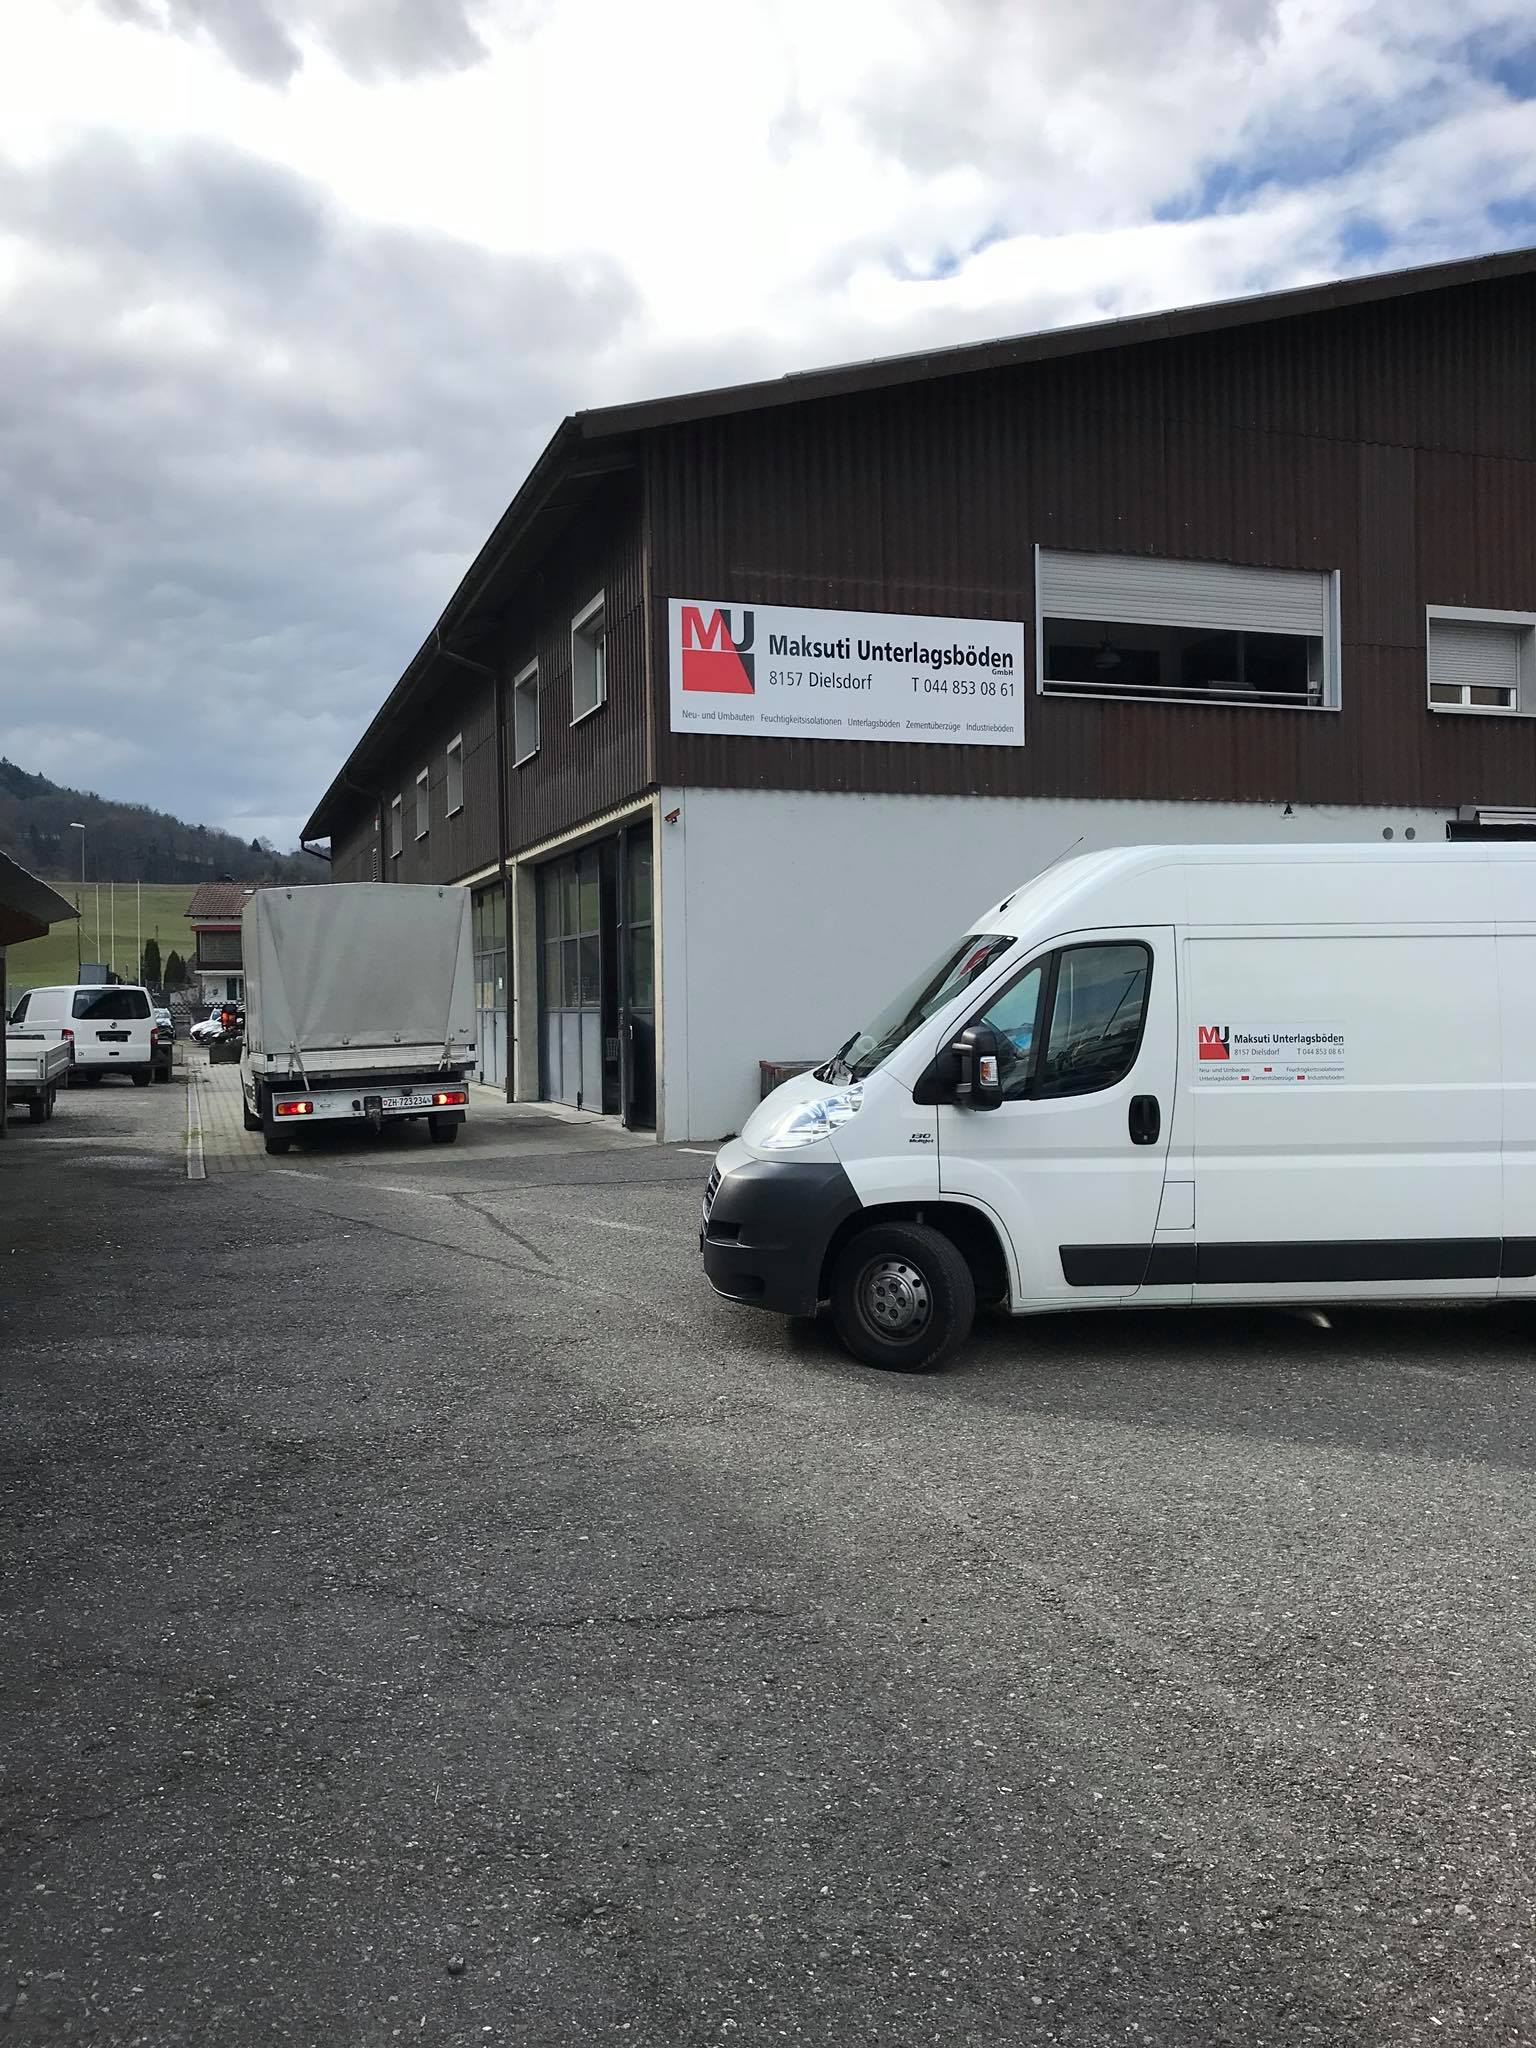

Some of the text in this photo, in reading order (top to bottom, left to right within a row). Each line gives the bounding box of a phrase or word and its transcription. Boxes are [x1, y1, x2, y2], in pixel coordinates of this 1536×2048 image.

[769, 634, 1013, 670] Maksuti Unterlagsböden
[769, 671, 872, 689] 8157 Dielsdorf
[991, 668, 1014, 676] GmbH
[912, 677, 1014, 697] T 044 853 08 61
[682, 710, 700, 719] Neu-
[701, 711, 716, 720] und
[717, 712, 755, 722] Umbauten
[760, 713, 842, 726] Feuchtigkeitsisolationen
[1234, 1033, 1344, 1046] Maksuti Unterlagsböden
[1233, 1048, 1280, 1056] 8157 Dielsdorf
